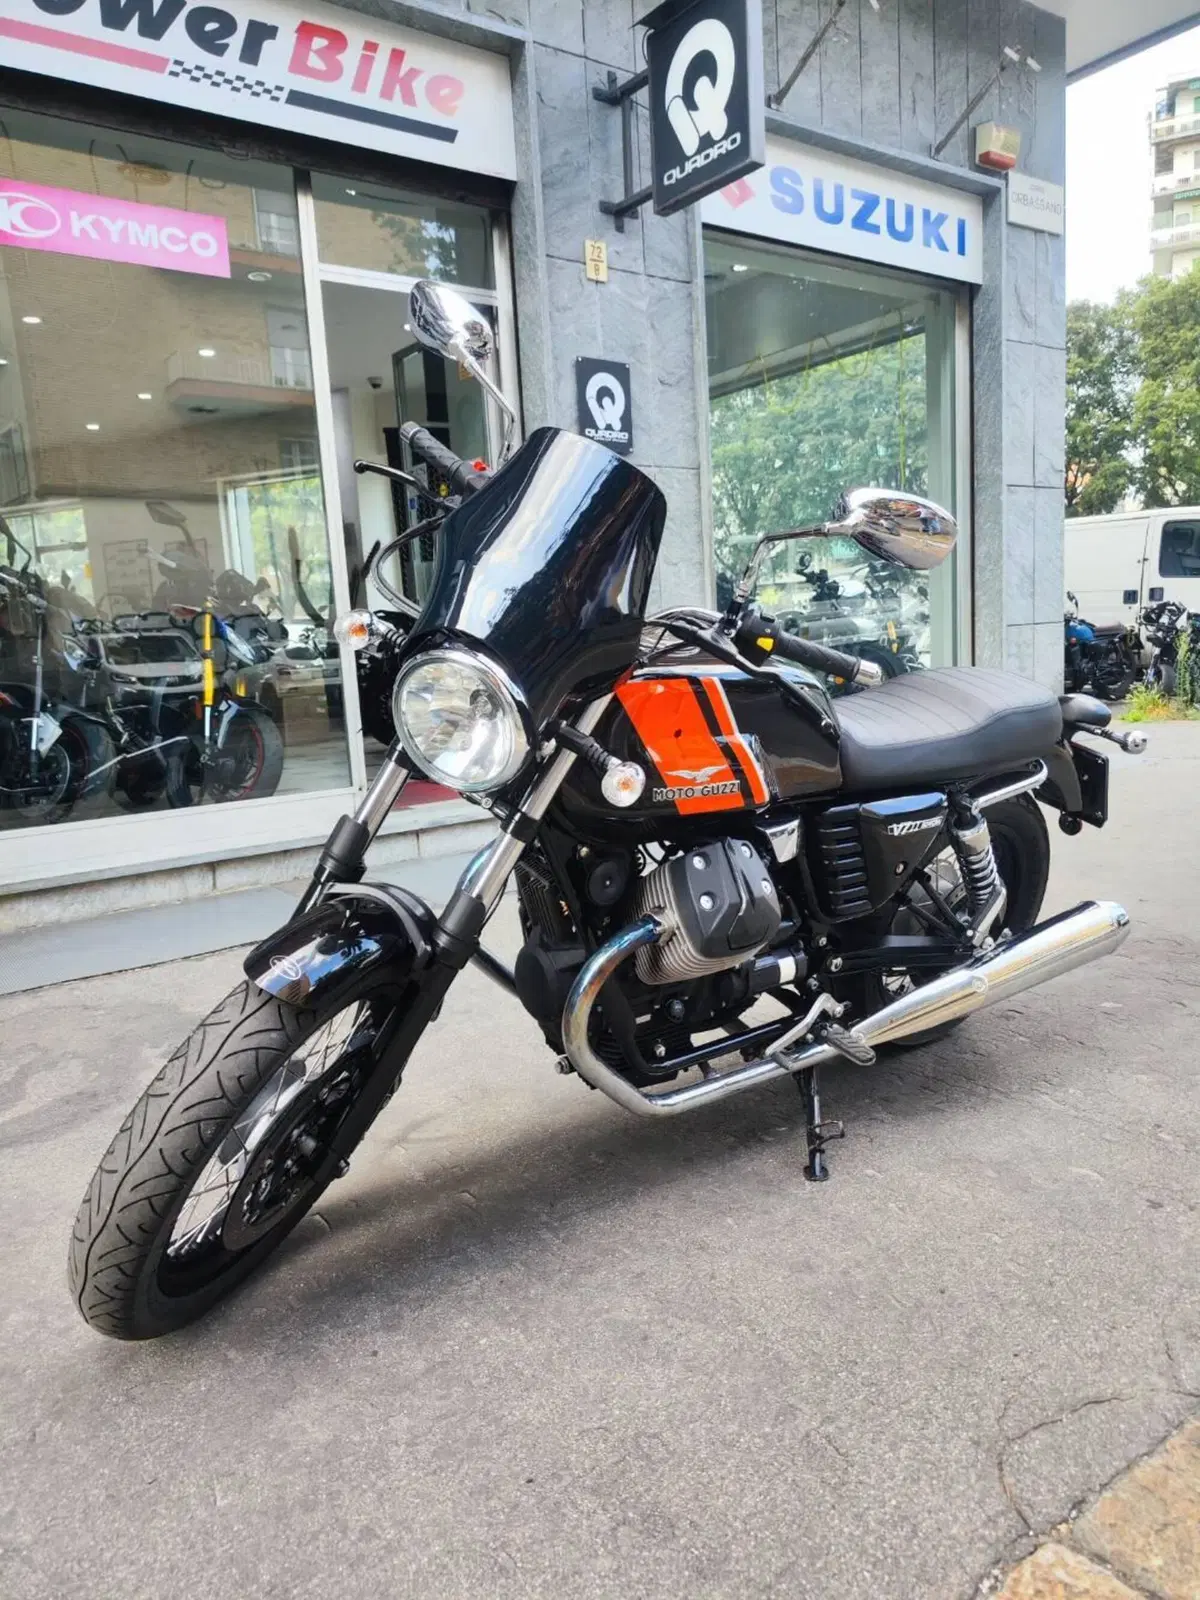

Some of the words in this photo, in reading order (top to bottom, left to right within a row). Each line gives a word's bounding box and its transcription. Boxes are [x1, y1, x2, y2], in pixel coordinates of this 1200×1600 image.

[288, 20, 465, 117] Bike
[663, 131, 742, 187] QUADRO
[69, 210, 218, 257] KYMCO
[769, 165, 966, 257] SUZUKI
[585, 428, 629, 440] QUADRO
[653, 786, 695, 802] MOTO
[701, 780, 740, 797] GUZZI
